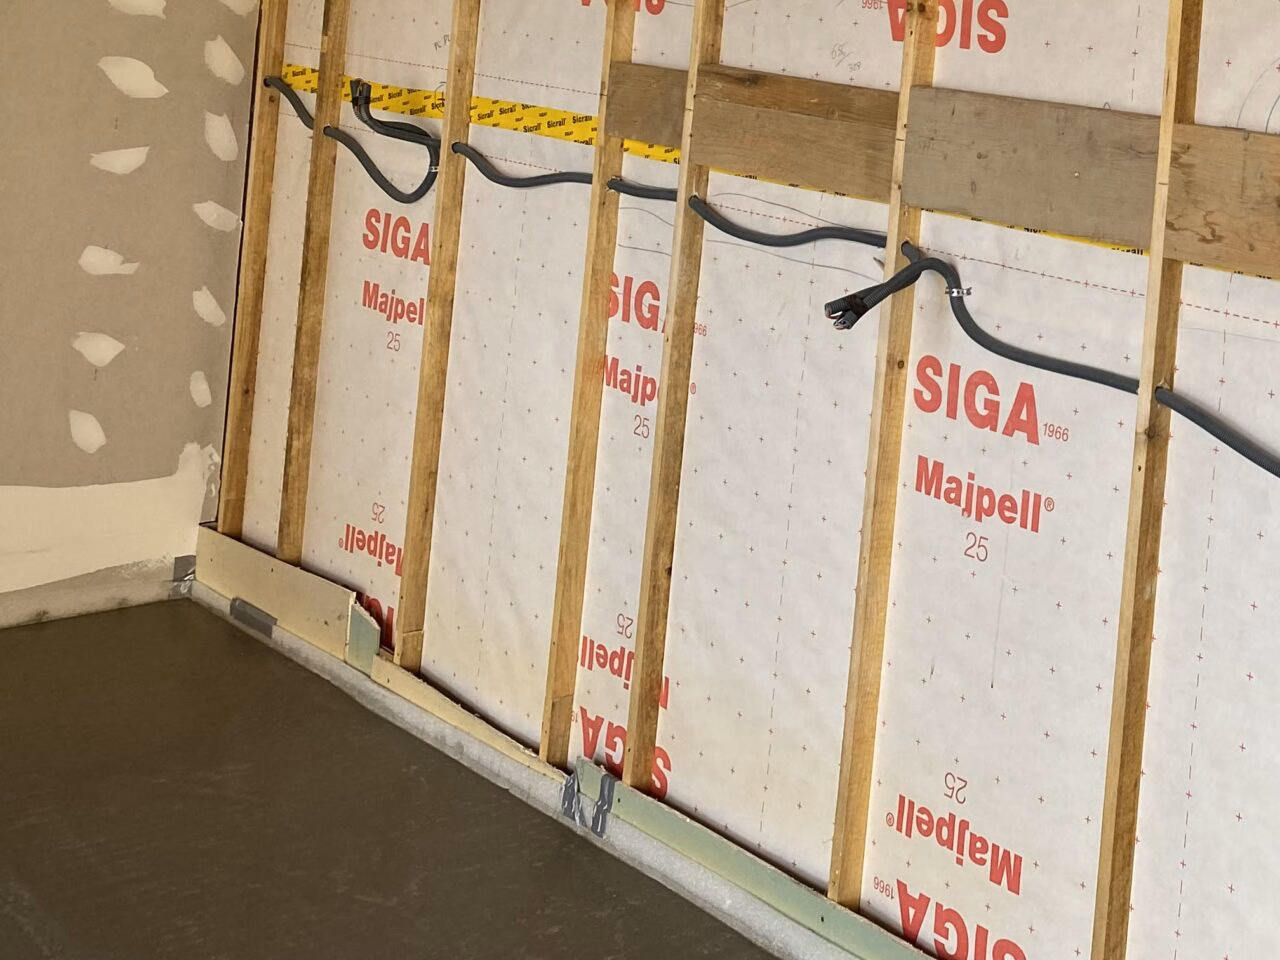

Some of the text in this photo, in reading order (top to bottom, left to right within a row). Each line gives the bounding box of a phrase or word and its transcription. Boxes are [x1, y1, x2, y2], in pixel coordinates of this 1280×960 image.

[362, 208, 431, 266] SIGA
[386, 331, 400, 351] 25
[913, 355, 1069, 445] SIGA 1966
[633, 414, 650, 439] 25
[964, 533, 989, 562] 25
[617, 613, 634, 639] 25
[944, 772, 967, 804] 25
[873, 876, 895, 900] 1966
